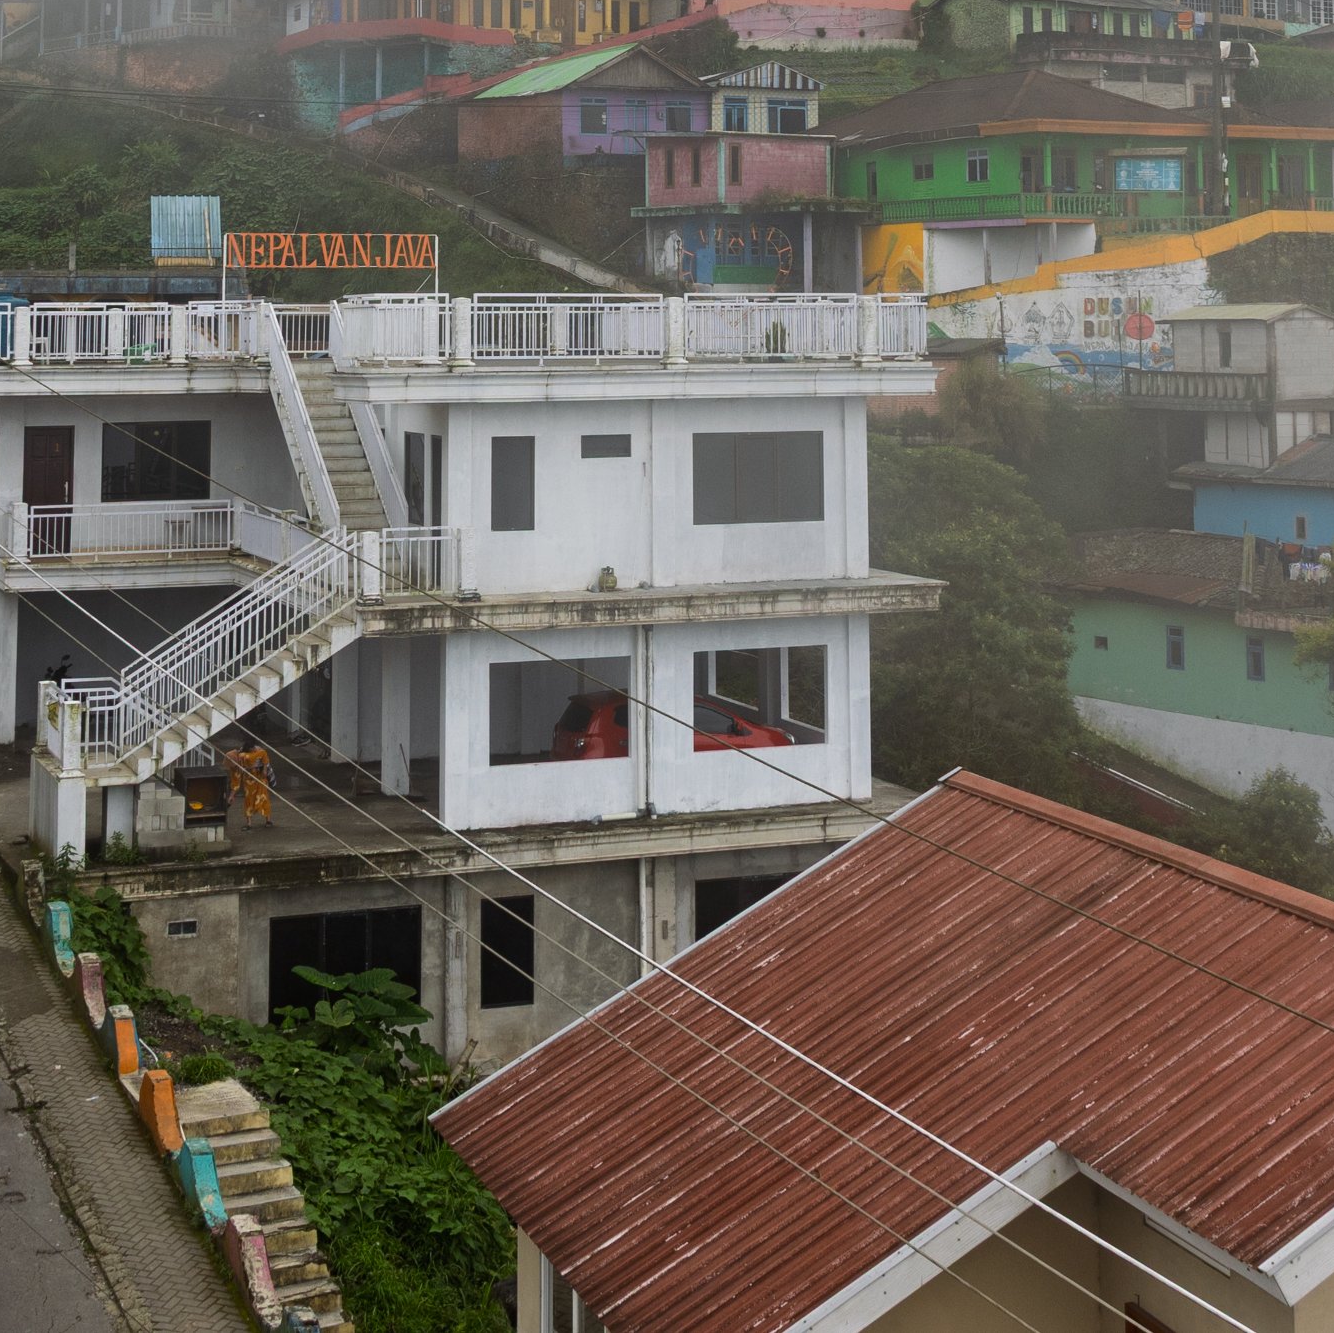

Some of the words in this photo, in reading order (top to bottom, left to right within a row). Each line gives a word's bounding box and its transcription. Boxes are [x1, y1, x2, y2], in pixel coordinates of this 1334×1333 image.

[226, 232, 317, 268] NEPAL
[318, 232, 371, 268] VAN
[375, 233, 436, 269] JAVA
[1083, 297, 1153, 316] DUSUN
